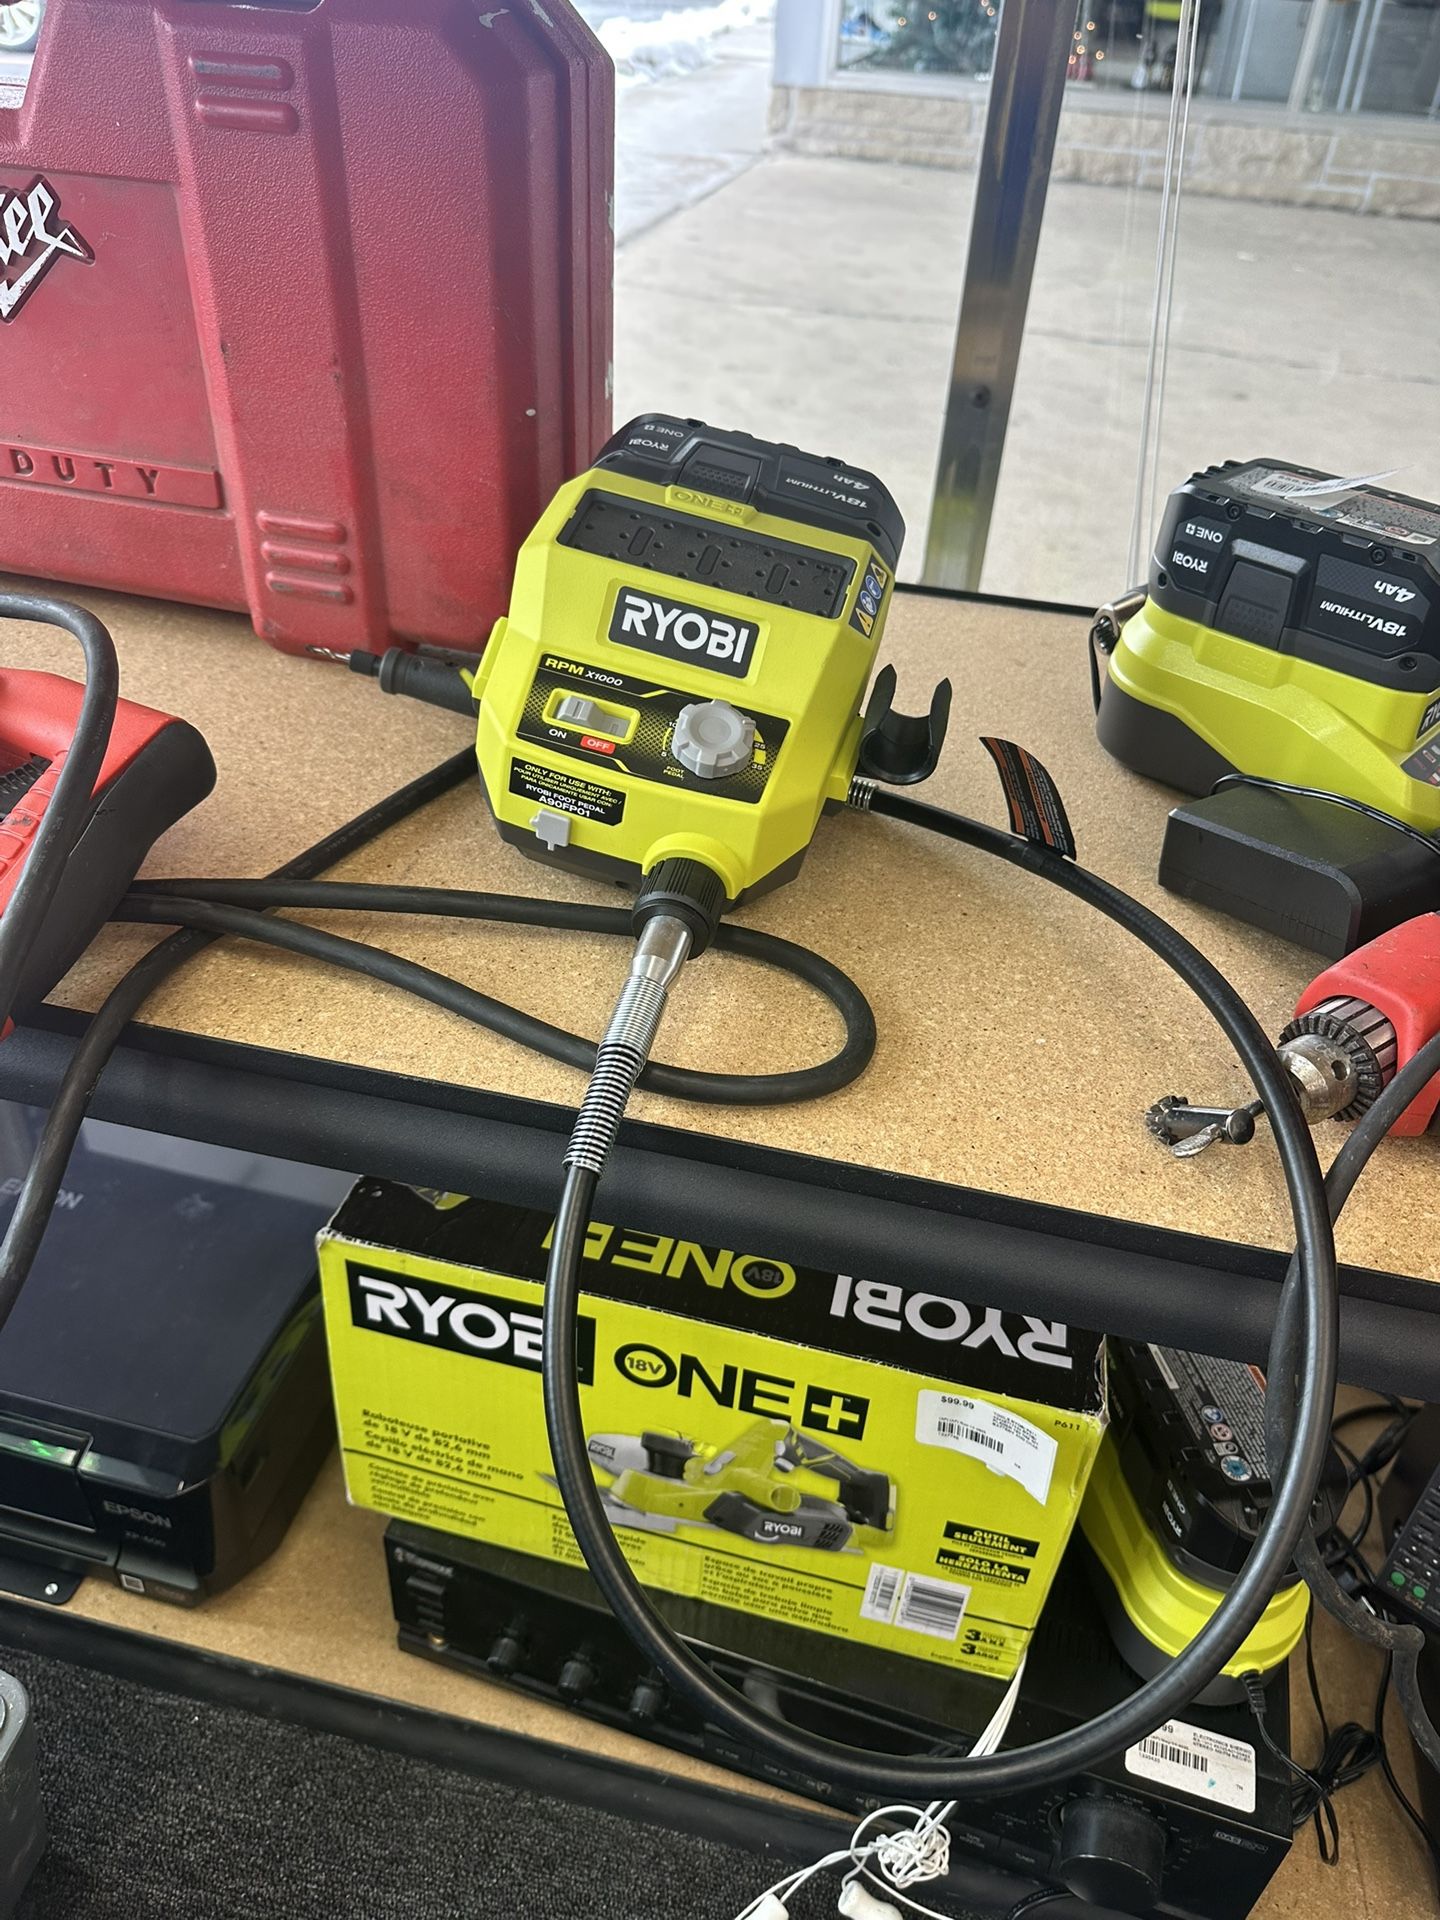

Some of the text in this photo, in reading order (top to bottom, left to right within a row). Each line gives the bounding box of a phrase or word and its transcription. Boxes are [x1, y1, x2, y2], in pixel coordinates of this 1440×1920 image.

[628, 437, 669, 451] RYOBI
[11, 448, 164, 496] DUTY
[833, 474, 870, 490] 4Ah
[1172, 550, 1209, 574] RYOBI
[1373, 579, 1417, 604] 4Ah
[621, 595, 750, 664] RYOBI
[545, 658, 623, 687] RPM X1000
[548, 728, 567, 740] ON
[586, 737, 610, 751] OFF
[513, 766, 531, 777] POUR
[663, 769, 686, 780] PEDAL
[666, 765, 685, 775] FOOT
[751, 763, 763, 771] 35
[520, 774, 537, 785] PARA
[524, 764, 612, 798] ONLY FOR USE WITH:
[525, 783, 606, 815] RYOBI FOOT PEDAL
[538, 794, 590, 818] A90FP01
[744, 1263, 783, 1285] 18V
[357, 1274, 583, 1374] RYOB
[829, 1274, 1073, 1370] RYOBI
[625, 1353, 665, 1376] 18V
[940, 1395, 975, 1410] $99.99
[1054, 1419, 1081, 1431] P611
[363, 1418, 379, 1428] de
[414, 1432, 430, 1443] de
[466, 1448, 490, 1460] mm
[432, 1429, 490, 1450] portative
[366, 1440, 382, 1449] de
[416, 1453, 432, 1463] de
[467, 1469, 491, 1480] mm
[467, 1459, 483, 1469] de
[487, 1465, 524, 1480] mano
[103, 1500, 172, 1529] EPSON
[763, 1520, 803, 1536] RYOBI
[973, 1529, 1010, 1542] OUTIL
[954, 1531, 1028, 1555] SEULEMENT
[938, 1556, 1026, 1583] HERRAMIENTA
[957, 1555, 1010, 1572] SOLO LA
[964, 1628, 982, 1642] 3
[960, 1642, 977, 1655] 3
